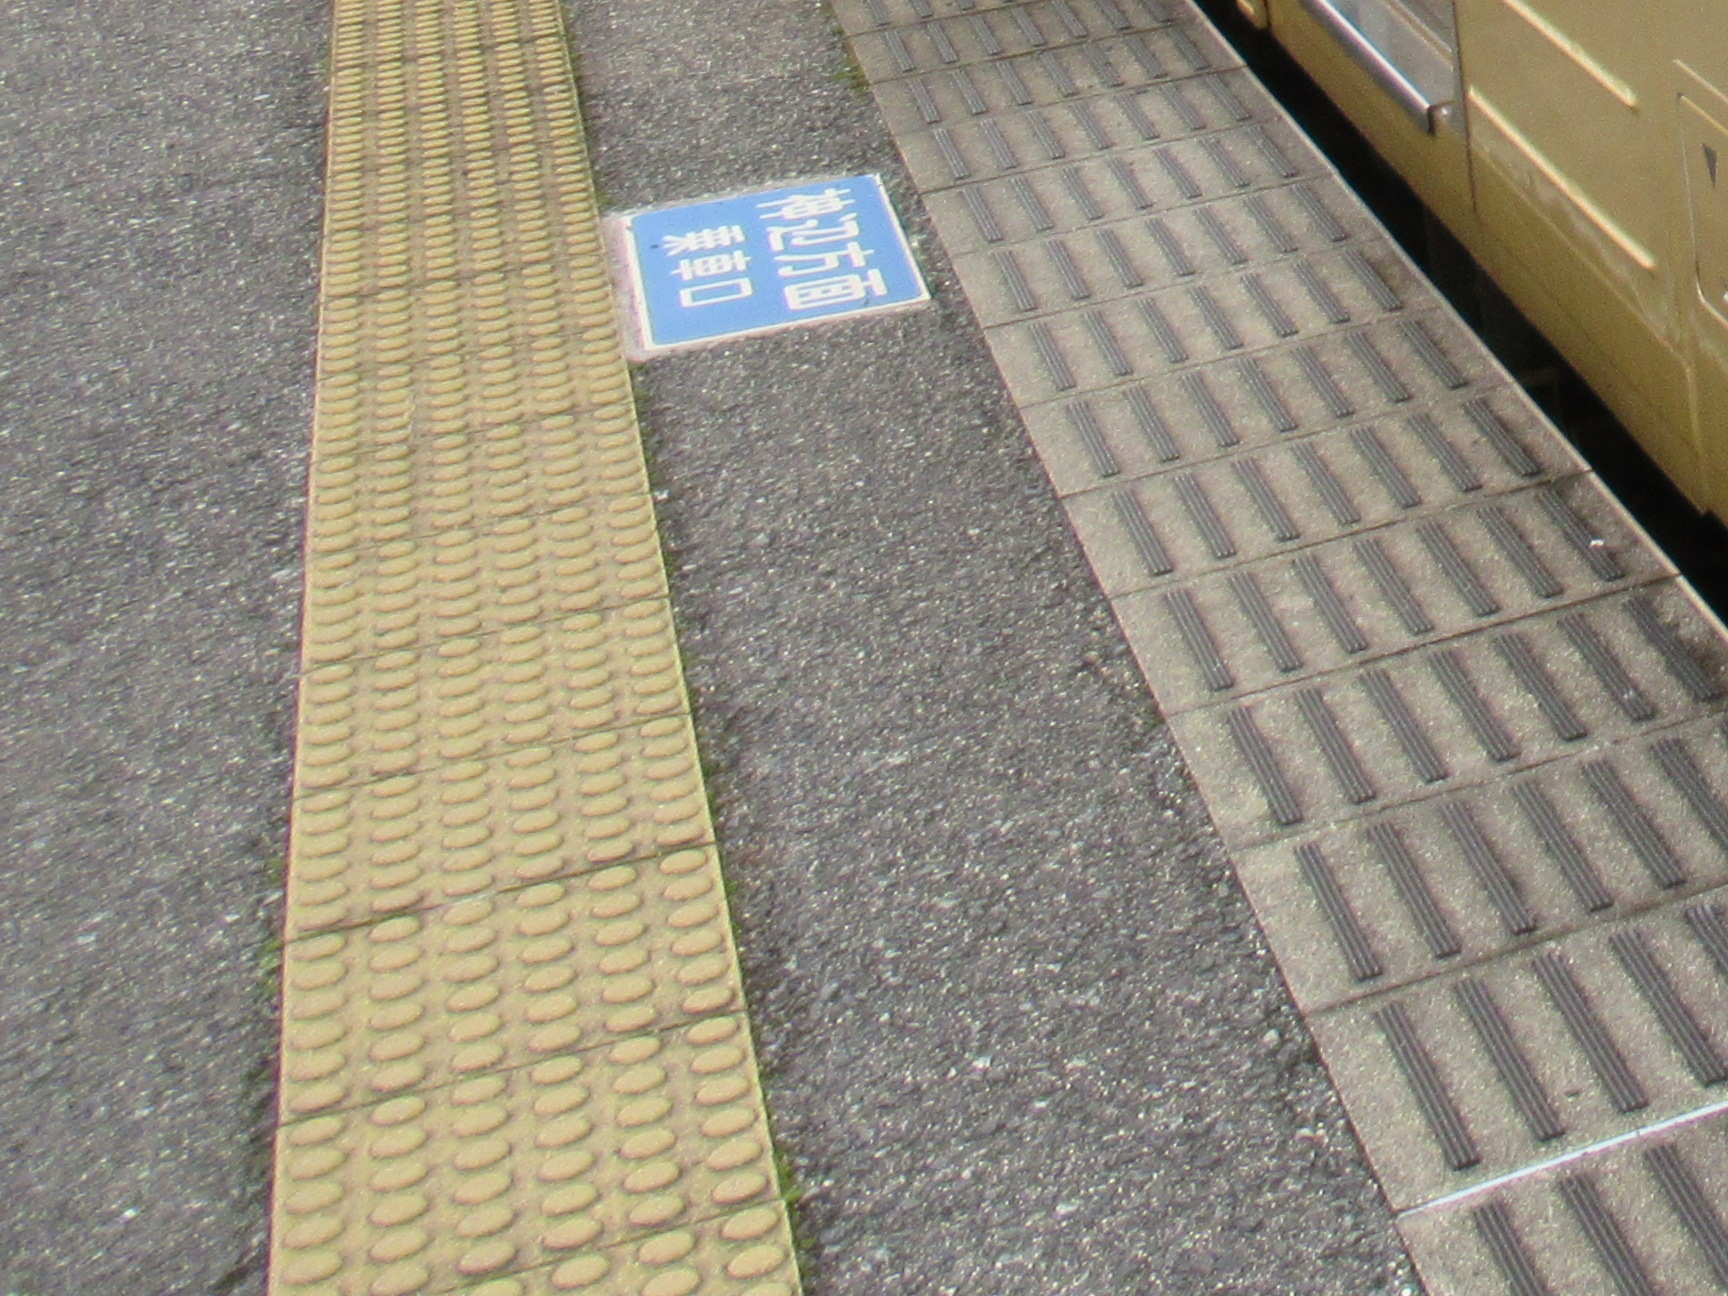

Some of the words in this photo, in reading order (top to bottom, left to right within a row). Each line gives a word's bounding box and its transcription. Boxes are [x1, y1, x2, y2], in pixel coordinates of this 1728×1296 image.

[662, 225, 753, 308] 乗車口
[756, 188, 889, 310] 神辺方面
